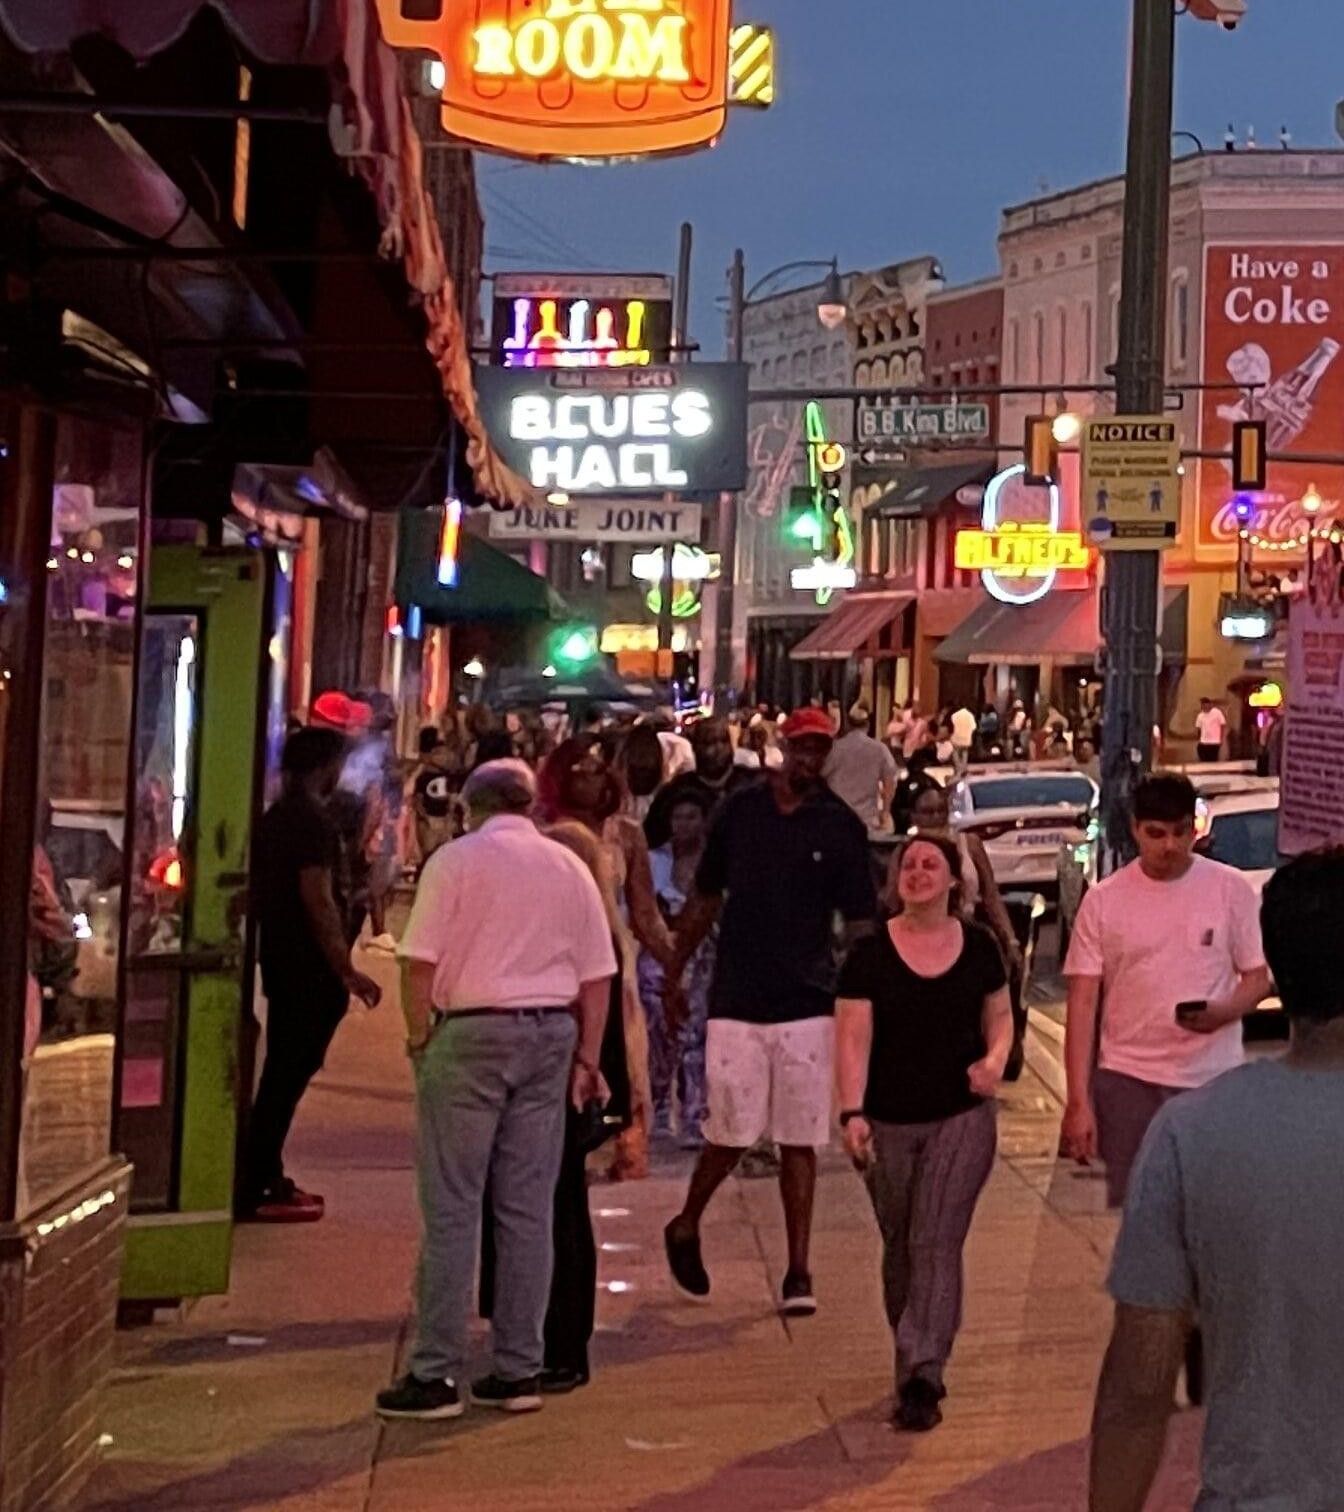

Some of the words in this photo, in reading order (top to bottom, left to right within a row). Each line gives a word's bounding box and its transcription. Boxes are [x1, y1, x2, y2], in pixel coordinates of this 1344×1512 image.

[473, 12, 690, 80] ROOM
[1229, 252, 1300, 279] Have
[1311, 259, 1329, 279] a
[1223, 285, 1331, 325] Coke
[509, 390, 714, 440] BLUES
[902, 409, 939, 437] King
[1089, 423, 1174, 442] NOTICE
[529, 441, 689, 489] HALL
[504, 497, 580, 531] JUKE
[596, 506, 684, 534] JOINT
